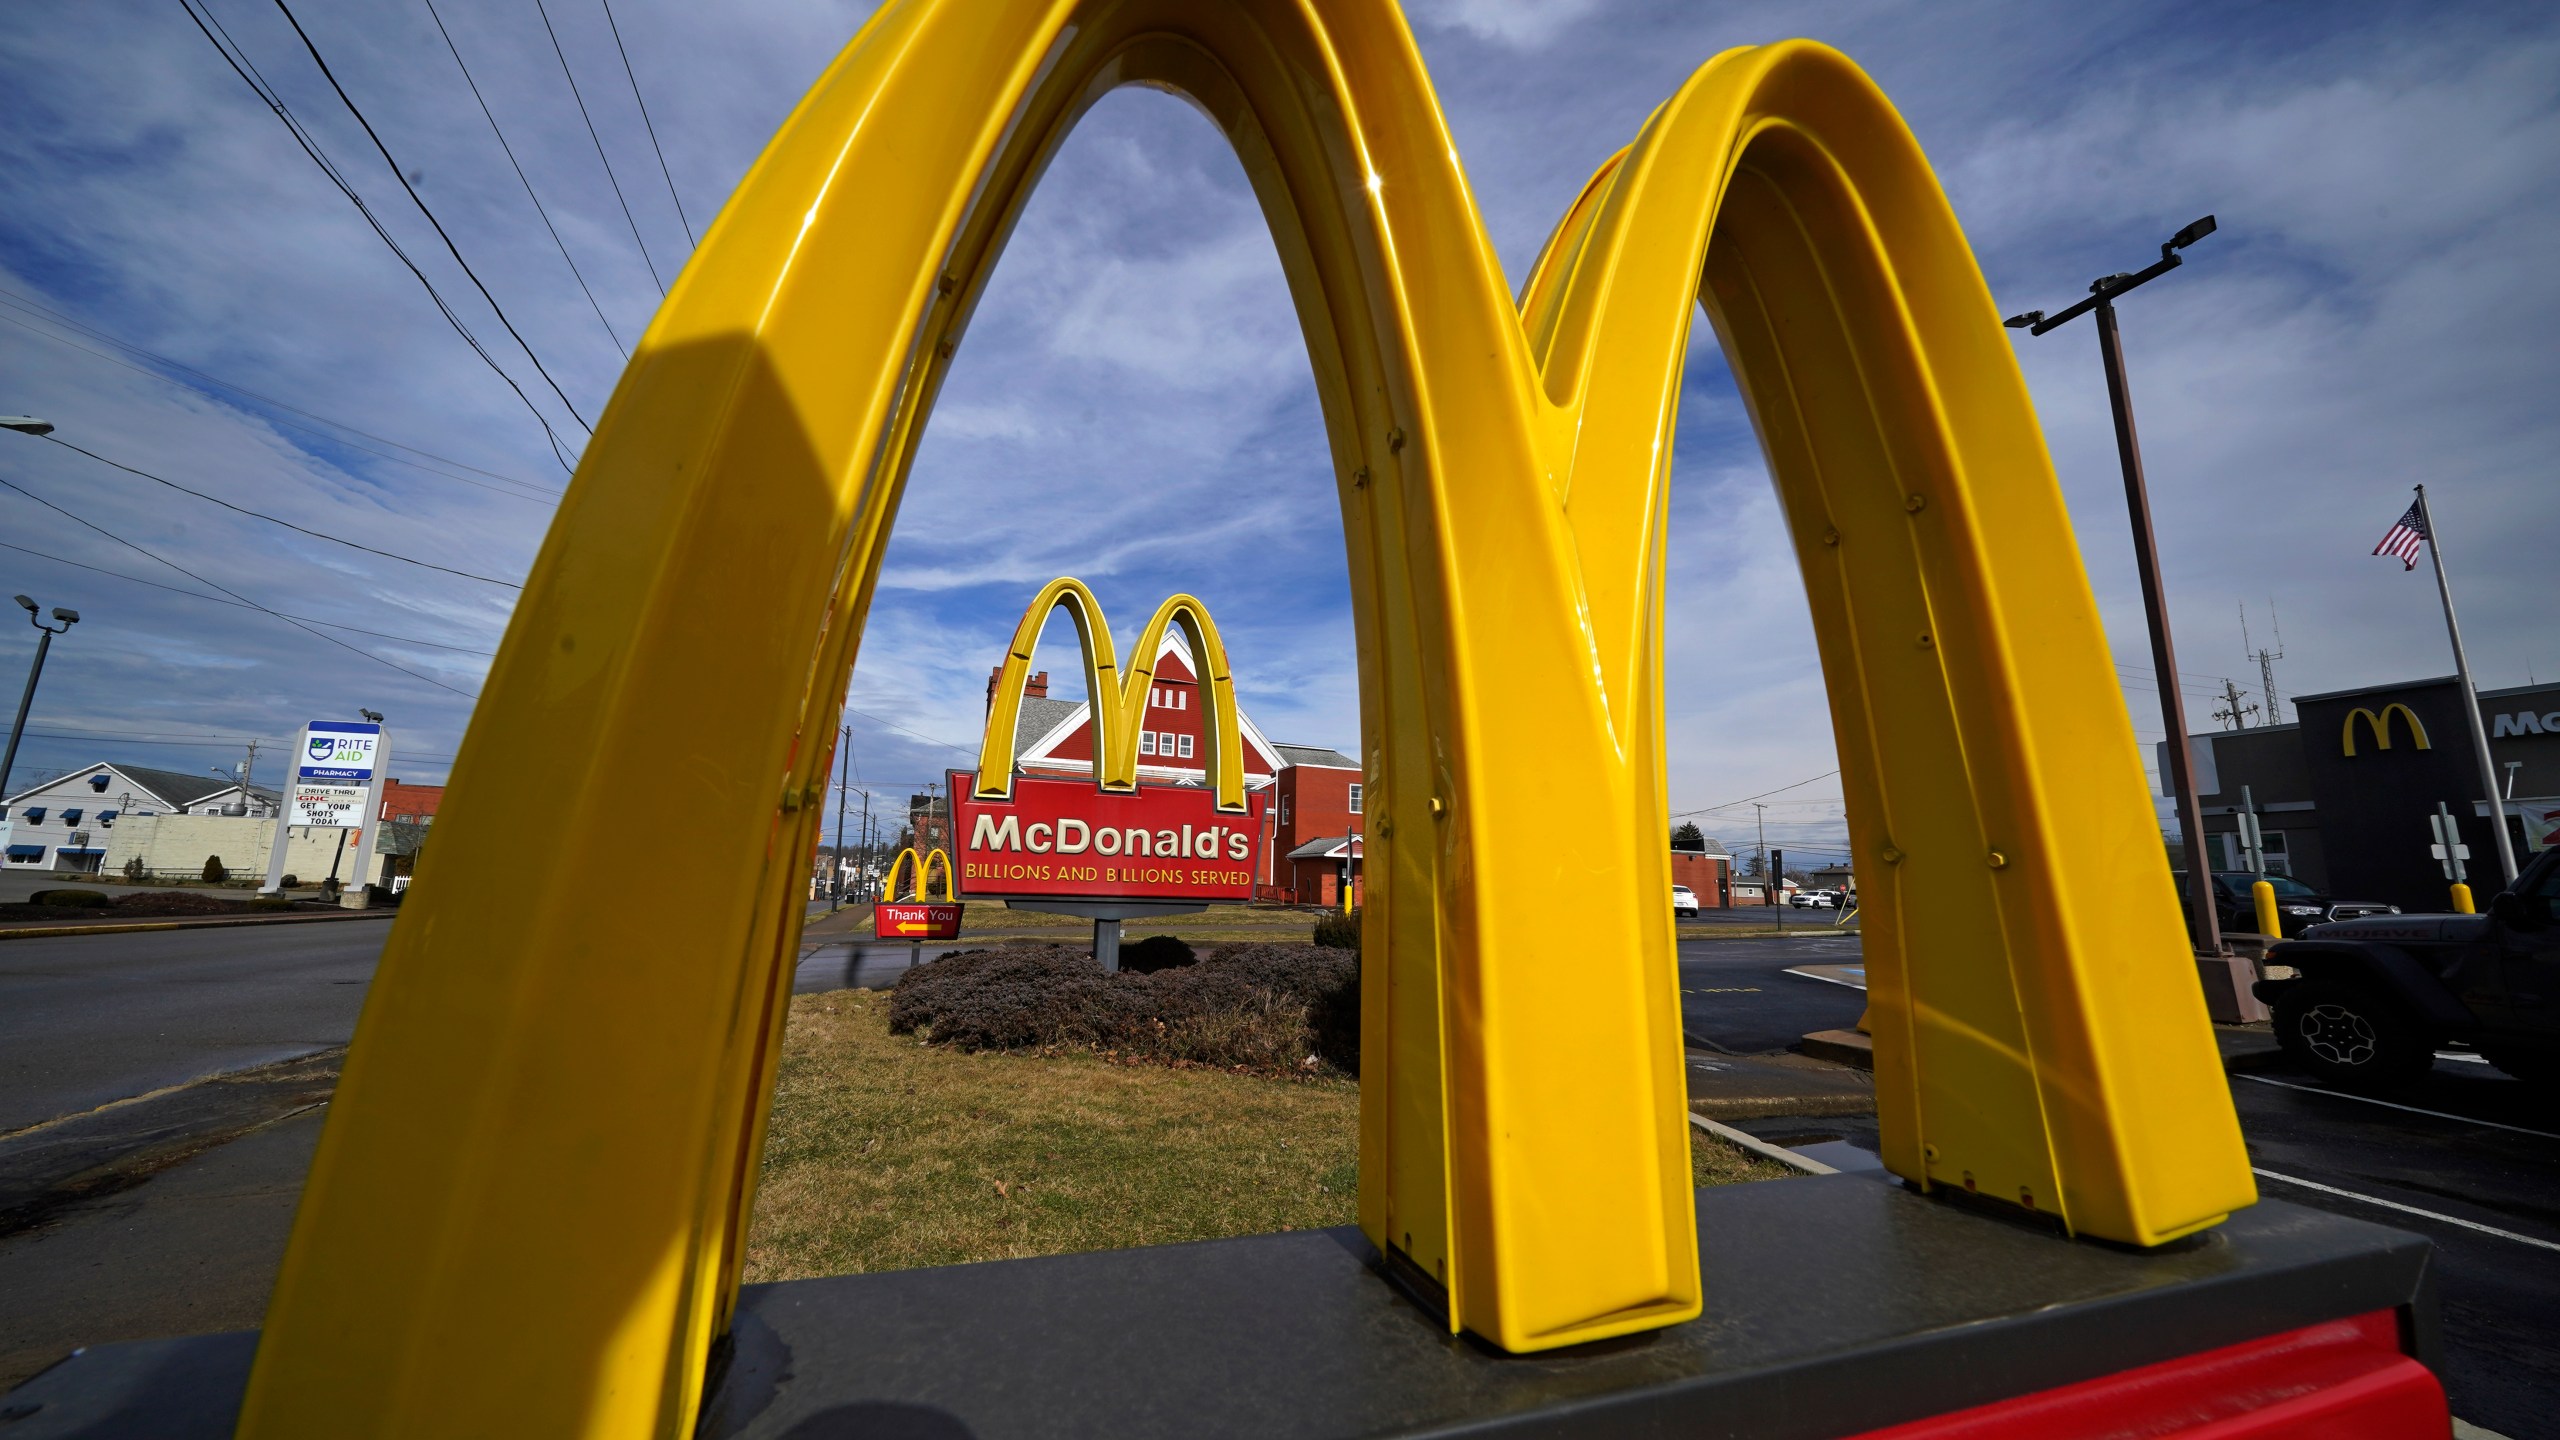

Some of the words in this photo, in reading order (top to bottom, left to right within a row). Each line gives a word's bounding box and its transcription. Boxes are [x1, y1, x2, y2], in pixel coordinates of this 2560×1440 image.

[338, 739, 373, 751] RITE
[335, 751, 363, 761] AID
[300, 802, 316, 810] GET
[327, 803, 351, 811] YOUR
[306, 810, 334, 818] SHOTS
[310, 817, 339, 826] TODAY
[970, 813, 1250, 861] McDonald's
[966, 863, 1051, 880] BILLIONS
[1056, 866, 1098, 881] AND
[1191, 870, 1250, 886] SERVED
[886, 908, 925, 921] Thank
[929, 909, 953, 921] You
[2317, 929, 2432, 939] MOJAVE
